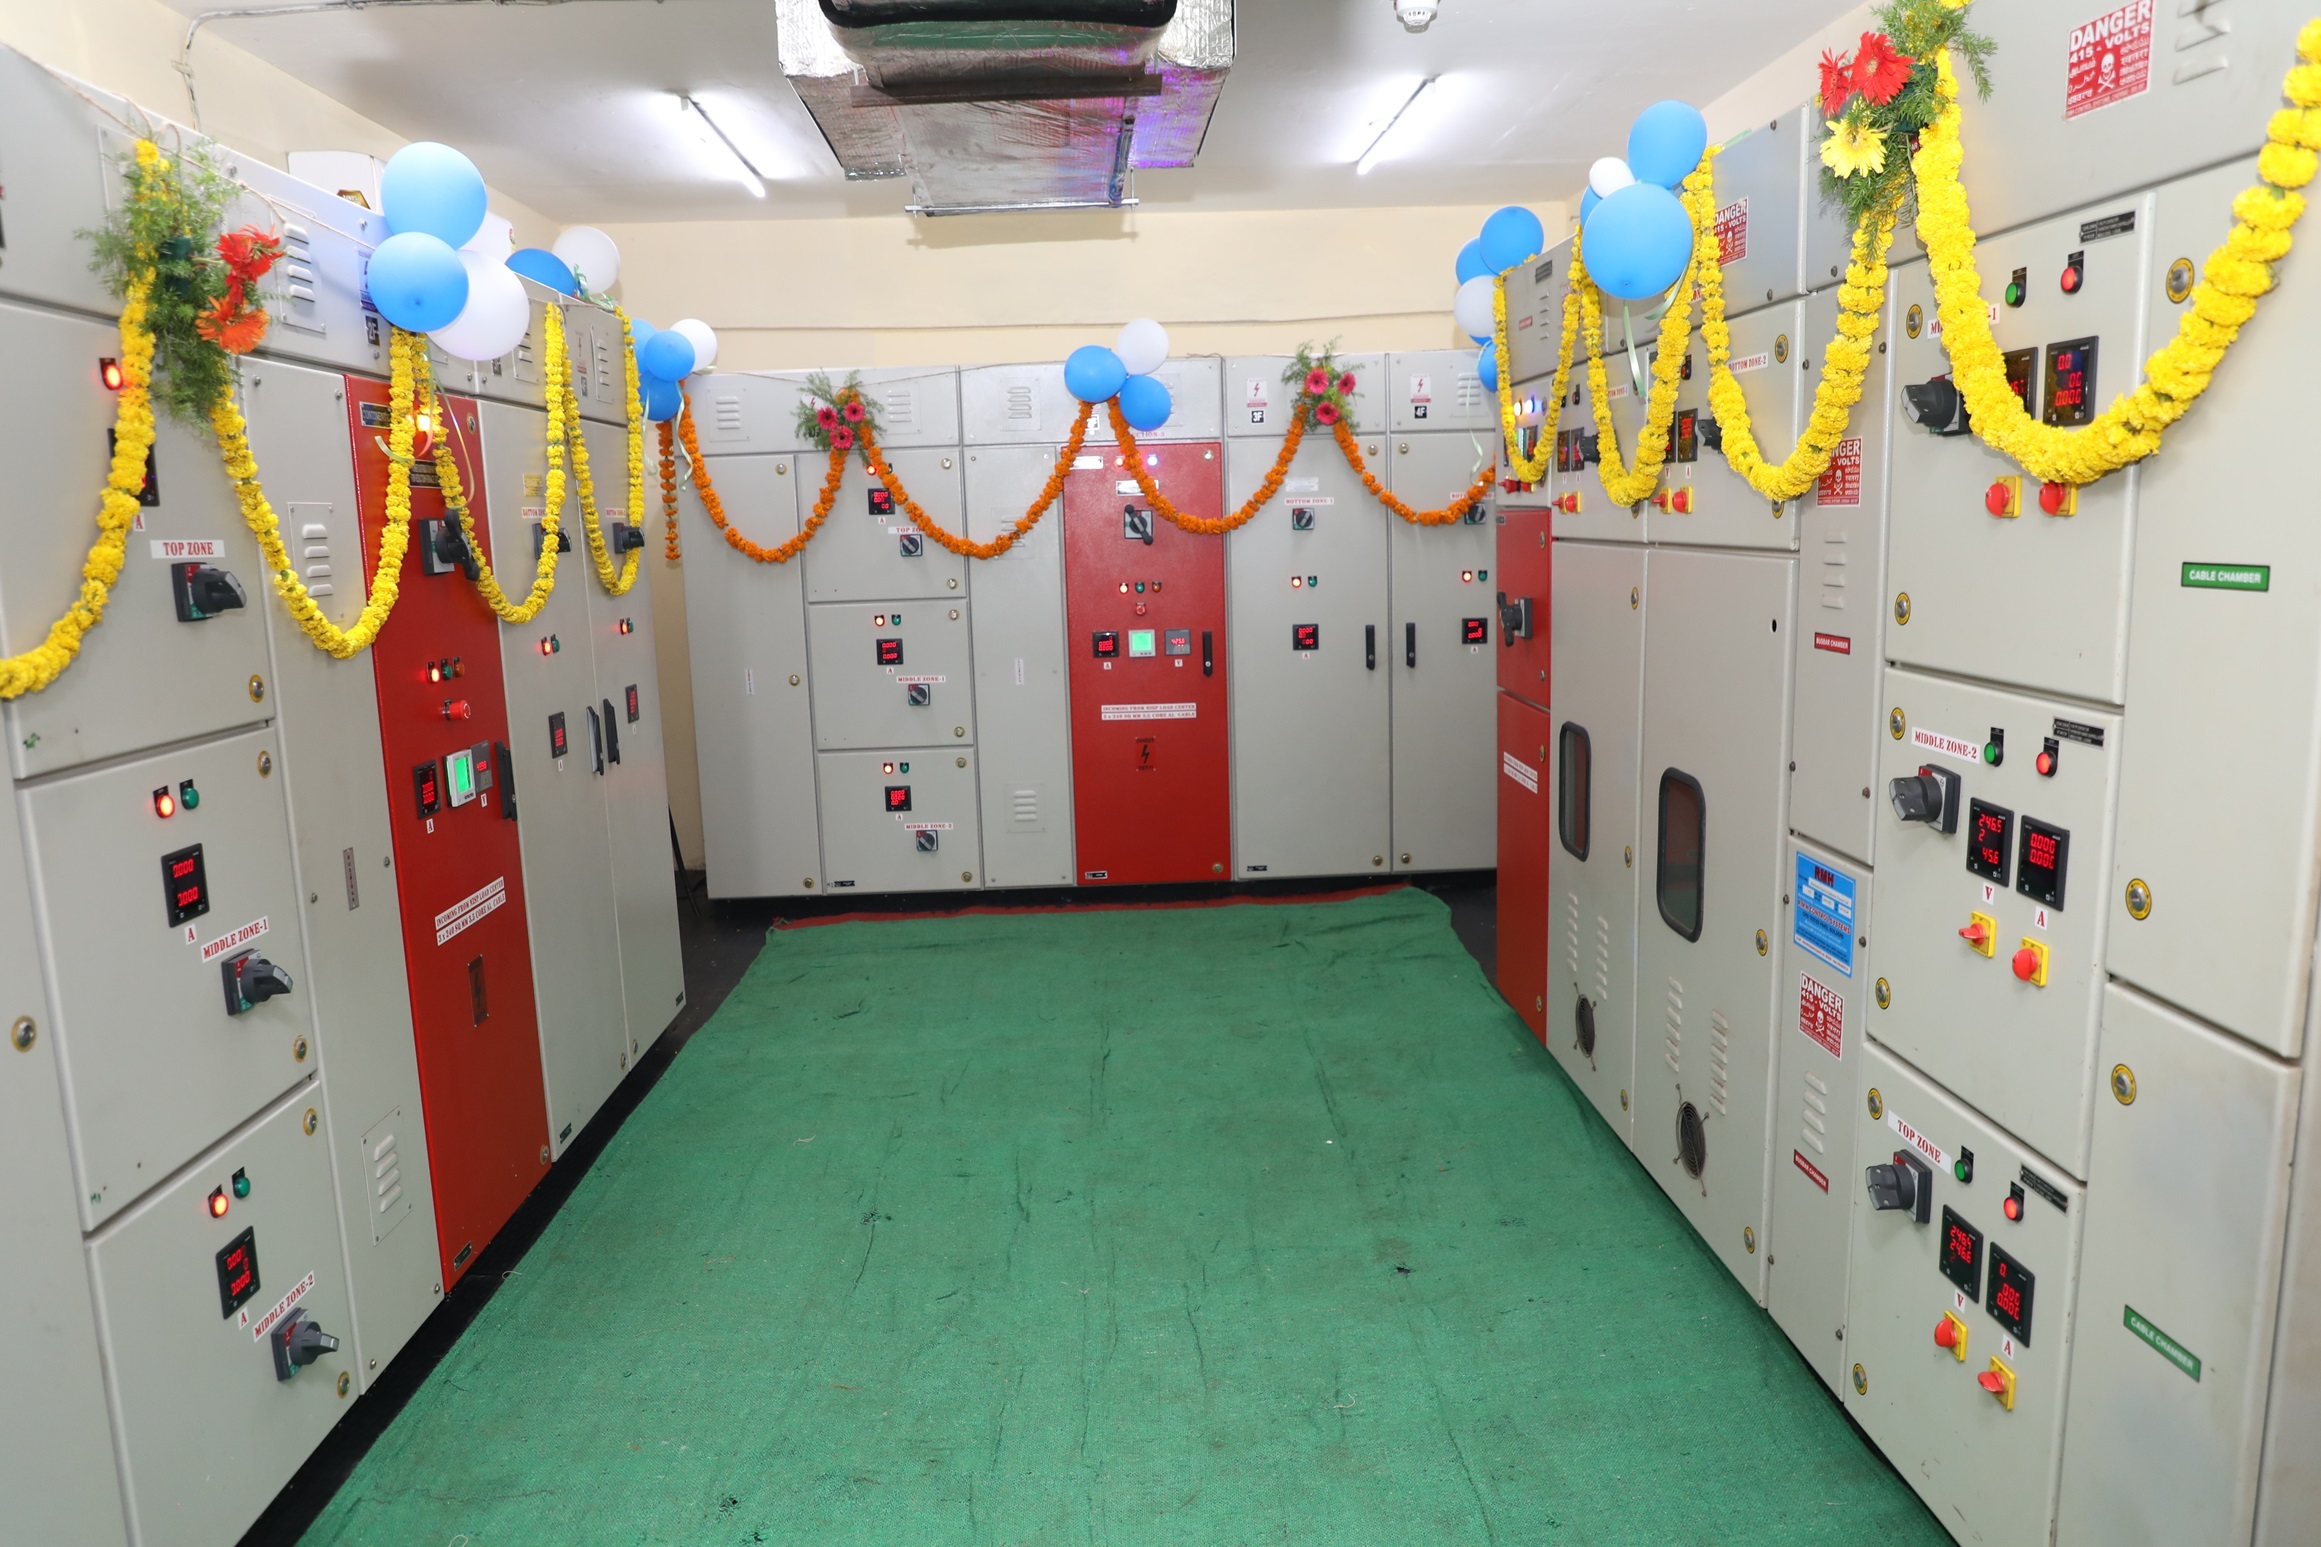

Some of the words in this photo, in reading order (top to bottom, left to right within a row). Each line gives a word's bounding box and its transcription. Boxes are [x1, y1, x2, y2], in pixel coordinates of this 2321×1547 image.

[2070, 0, 2152, 52] DANGER
[2069, 46, 2094, 63] 415
[2105, 22, 2150, 49] VOLTS
[1714, 201, 1747, 225] DANGER
[1715, 224, 1724, 233] 15
[1729, 215, 1747, 229] VOLTS
[1252, 411, 1263, 422] 3F
[1832, 440, 1860, 457] NGER
[1837, 456, 1860, 466] VOLTS
[136, 514, 144, 530] A
[163, 542, 185, 556] TOP
[186, 541, 214, 556] ZONE
[2189, 569, 2217, 582] CABLE
[2218, 571, 2262, 584] CHAMBER
[1914, 730, 1945, 751] MIDDLE
[1946, 740, 1977, 760] ZONE-2
[1814, 865, 1835, 888] RMH
[1985, 885, 1993, 901] V
[436, 908, 458, 927] INCOMING
[457, 901, 470, 914] FROM
[461, 917, 469, 928] MM
[2036, 910, 2046, 928] A
[187, 927, 196, 943] A
[1829, 917, 1851, 935] SYSTEMS
[203, 932, 237, 960] MIDDLE
[238, 918, 269, 944] ZONE-1
[1801, 975, 1842, 1013] DANGER
[1801, 989, 1814, 1003] 415
[1819, 999, 1842, 1021] VOLTS
[1897, 1119, 1916, 1142] TOP
[1916, 1132, 1941, 1164] ZONE
[254, 1302, 285, 1338] MIDDLE
[284, 1273, 315, 1313] ZONE-2
[1956, 1291, 1965, 1308] V
[240, 1312, 248, 1328] A
[2004, 1339, 2012, 1357] A
[2130, 1315, 2155, 1341] CABLE
[2154, 1331, 2195, 1372] CHAMBER
